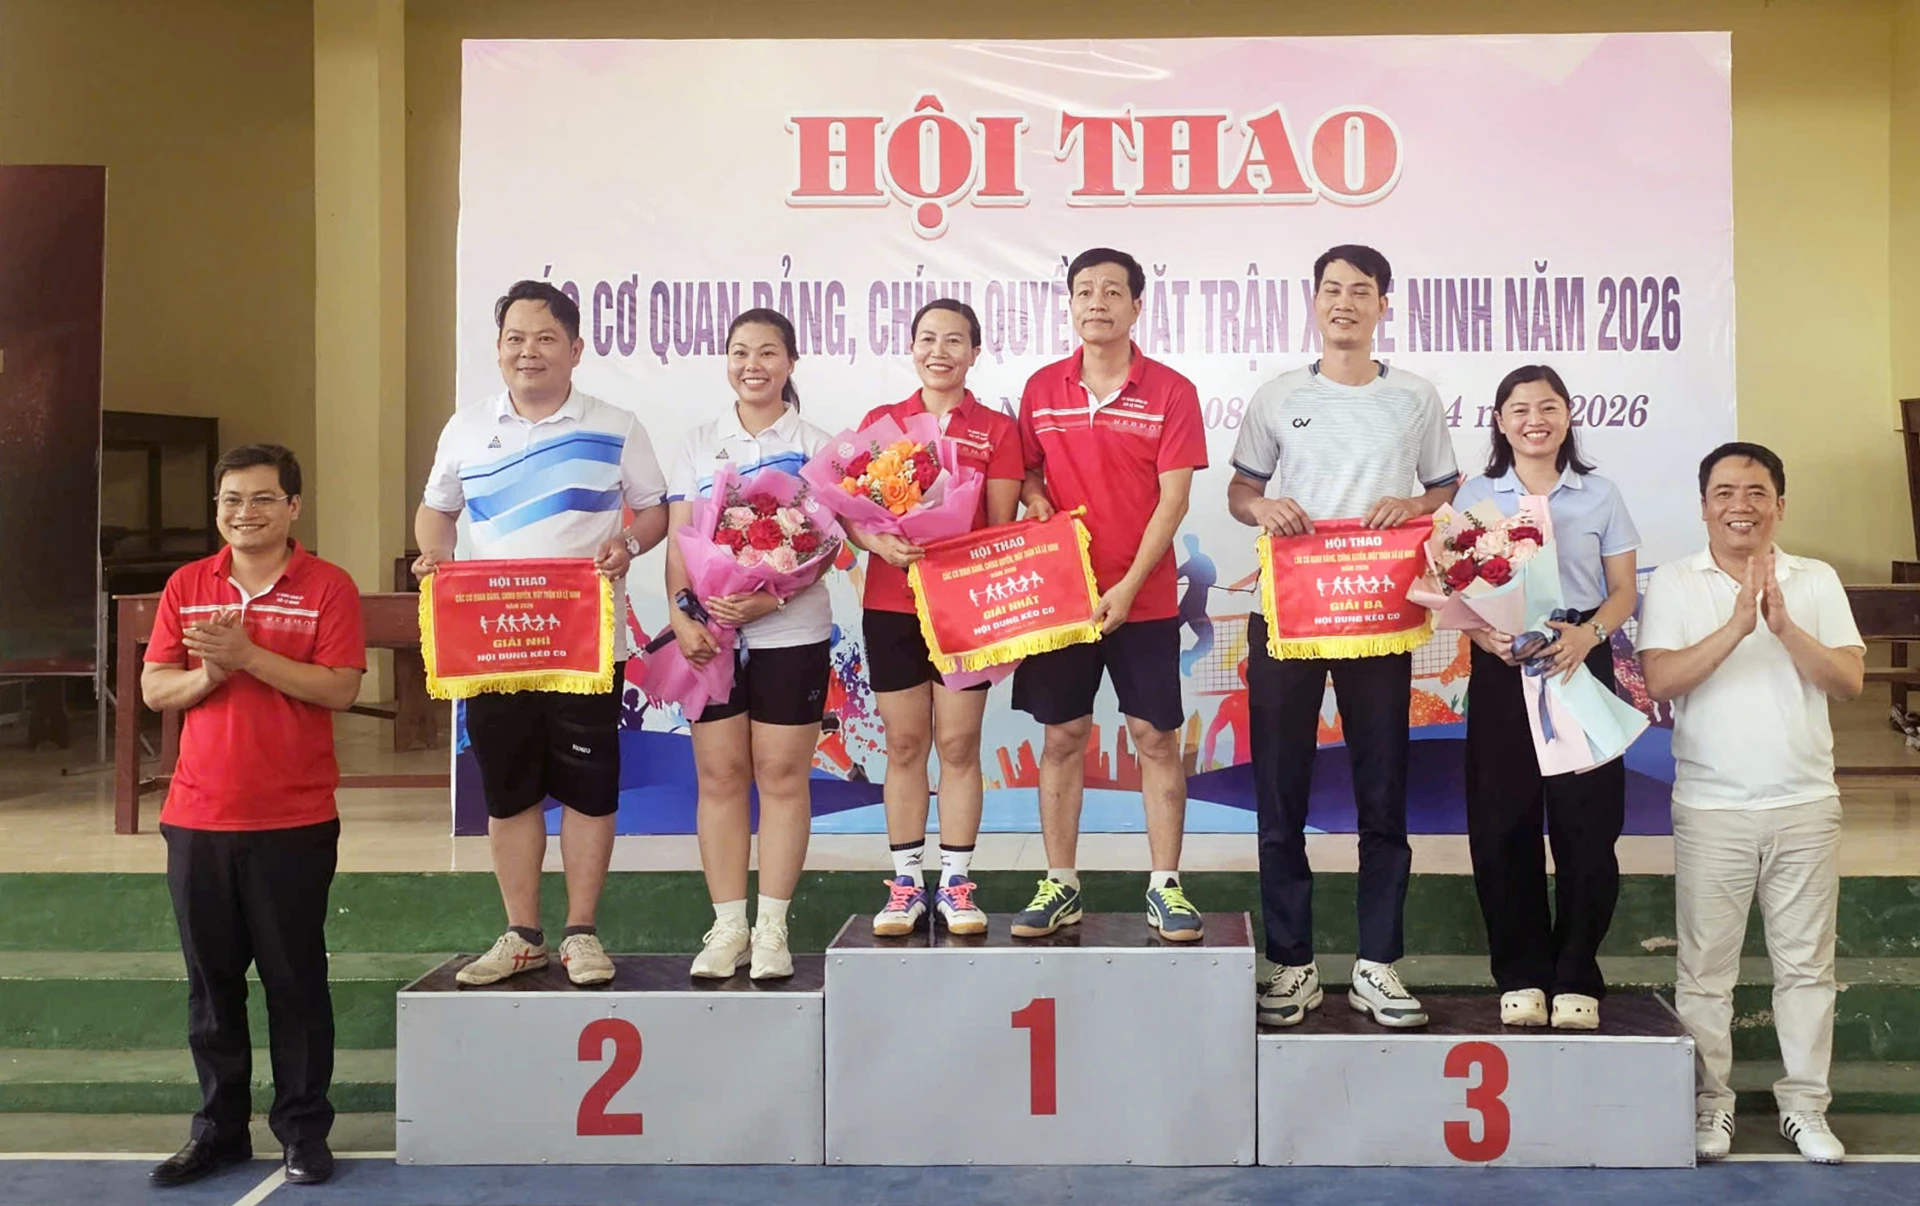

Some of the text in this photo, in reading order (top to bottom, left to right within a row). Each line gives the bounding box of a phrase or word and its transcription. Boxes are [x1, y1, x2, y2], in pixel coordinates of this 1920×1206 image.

[788, 92, 1400, 232] HỘI THAO
[593, 273, 638, 356] CƠ
[650, 280, 740, 365] QUAN
[1200, 263, 1289, 371] TRẬN
[1408, 278, 1492, 352] NINH
[1505, 260, 1585, 352] NĂM
[1598, 276, 1681, 351] 2026
[969, 536, 1025, 560] HỘI THAO
[1324, 536, 1382, 550] HỘI THAO
[489, 576, 547, 588] HỘI THAO
[1364, 600, 1383, 609] BA
[498, 651, 527, 660] DUNG
[577, 1018, 643, 1136] 2
[1011, 997, 1057, 1115] 1
[1443, 1041, 1511, 1162] 3
